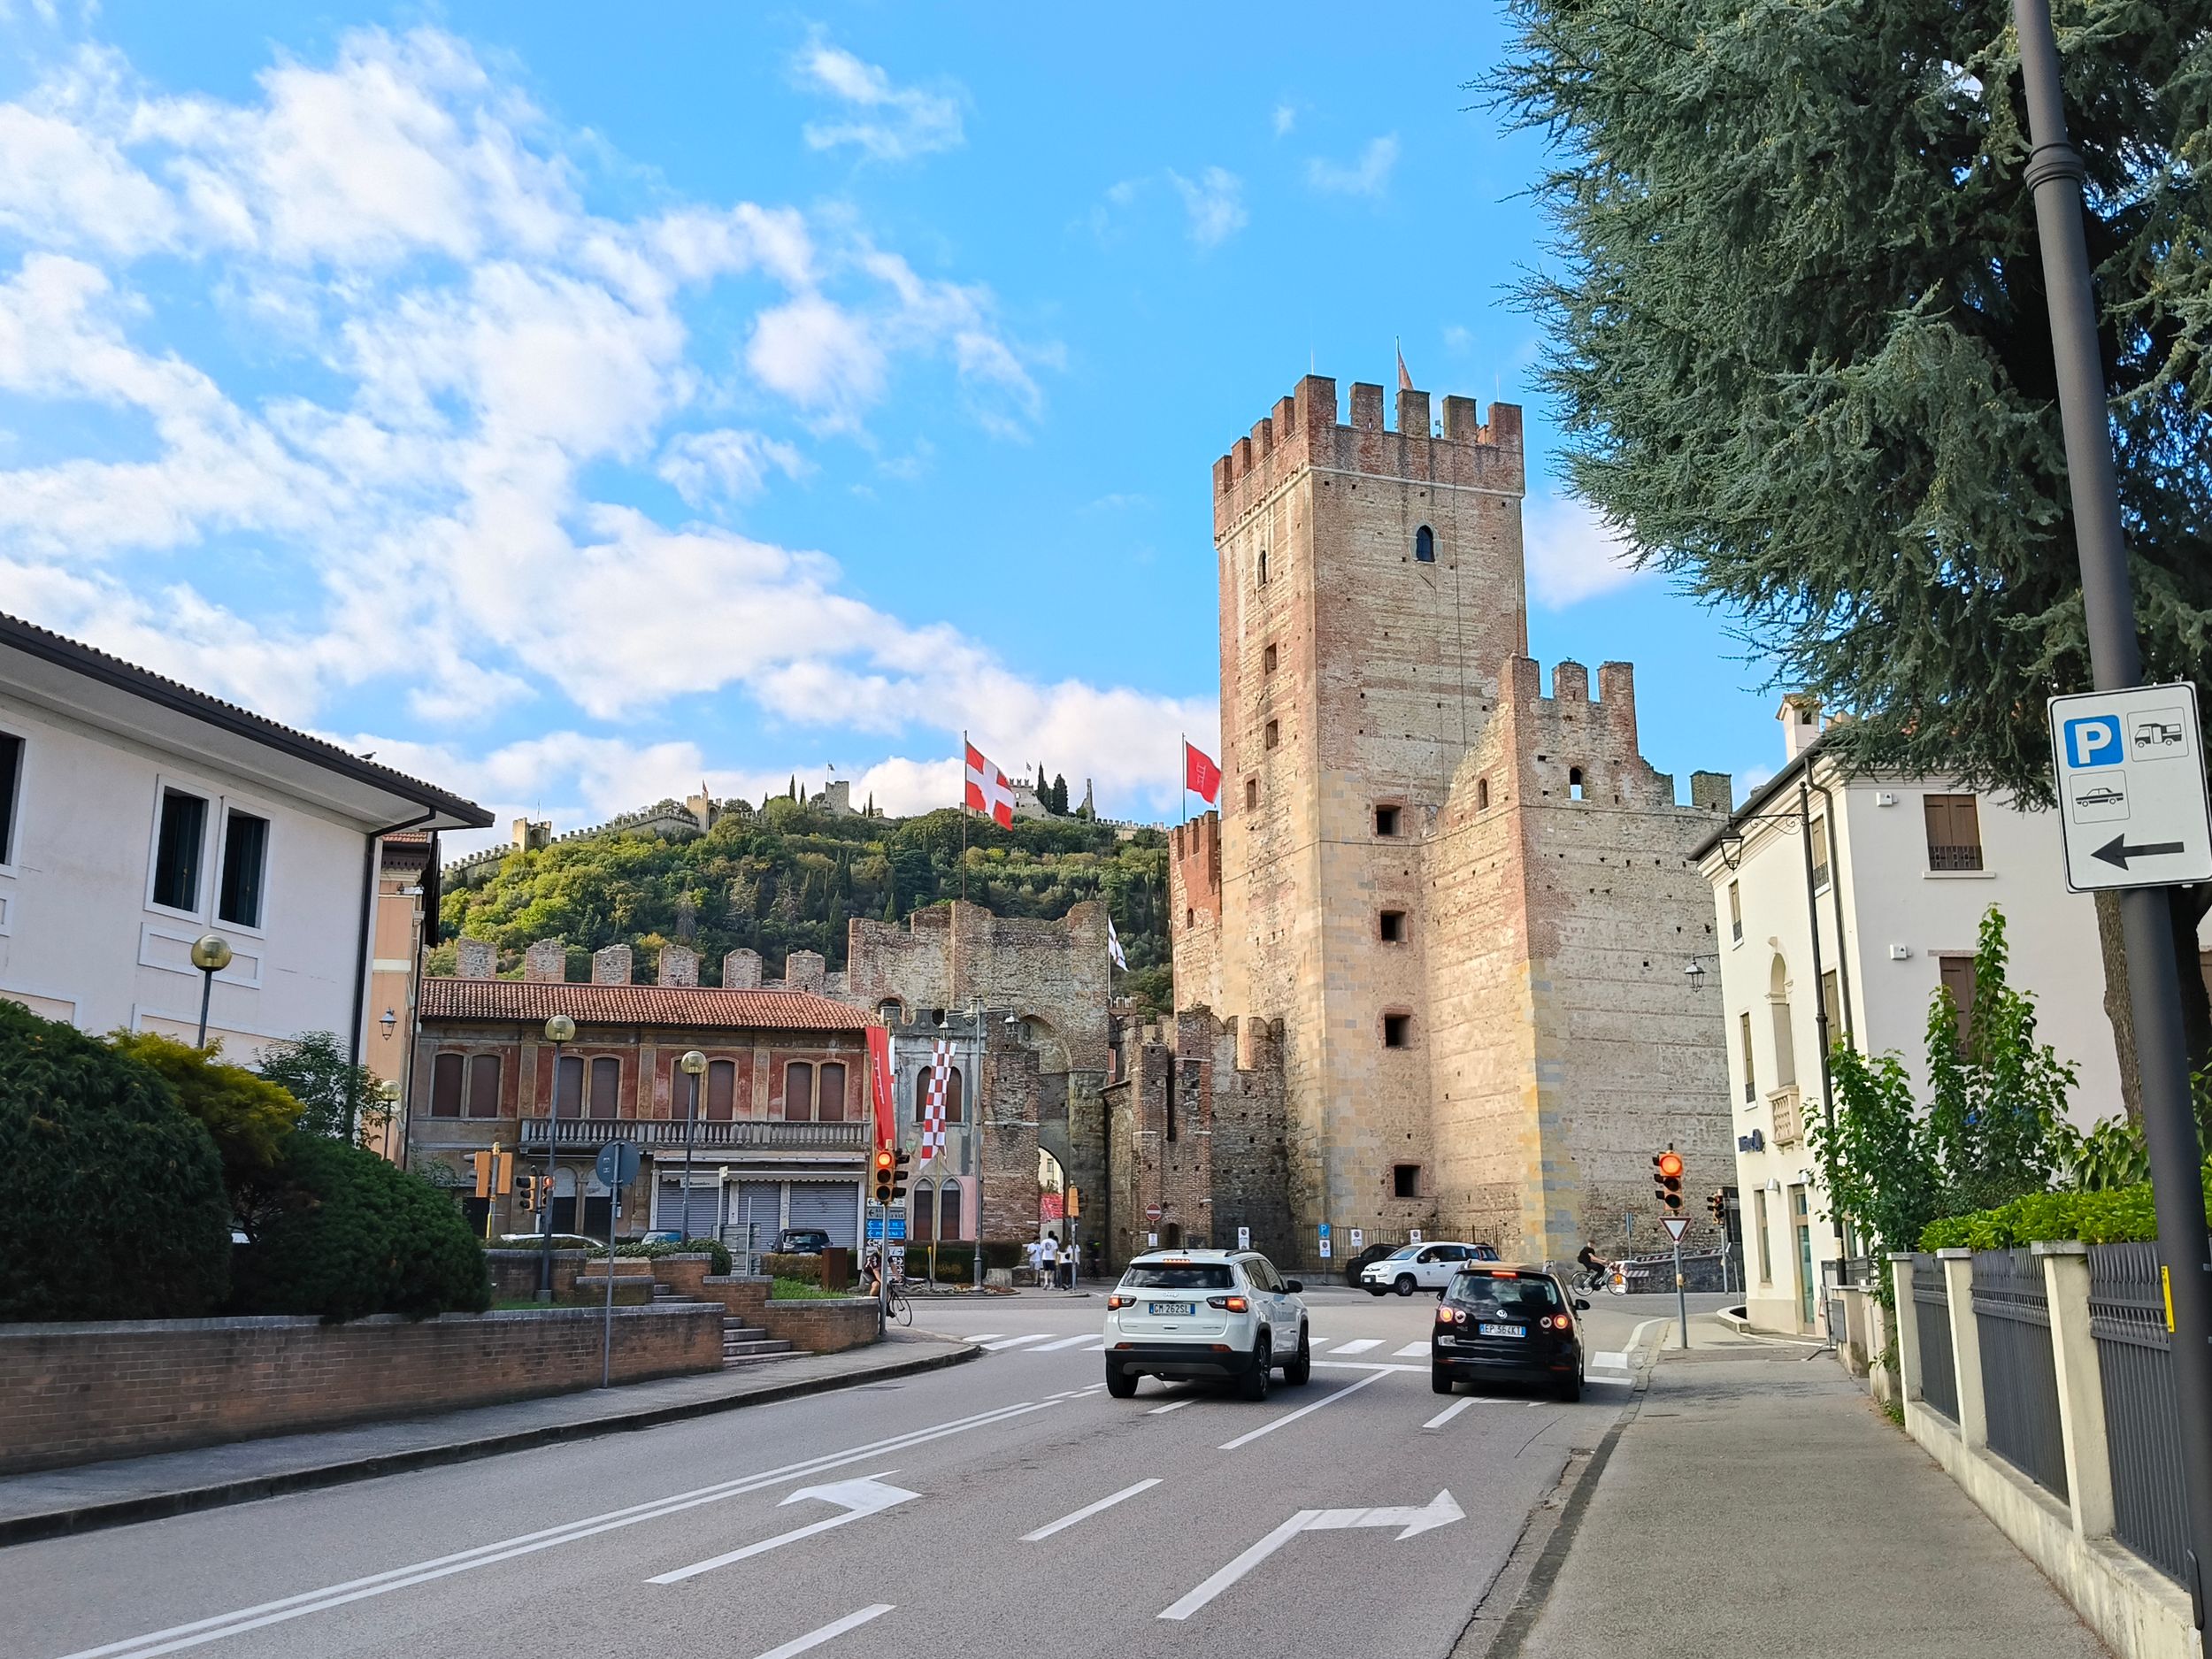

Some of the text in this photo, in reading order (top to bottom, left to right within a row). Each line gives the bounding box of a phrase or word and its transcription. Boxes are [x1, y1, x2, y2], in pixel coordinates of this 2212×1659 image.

[2074, 721, 2112, 764] P
[1320, 1225, 1327, 1233] P
[1165, 1304, 1189, 1313] 262SL
[1485, 1325, 1494, 1333] EP
